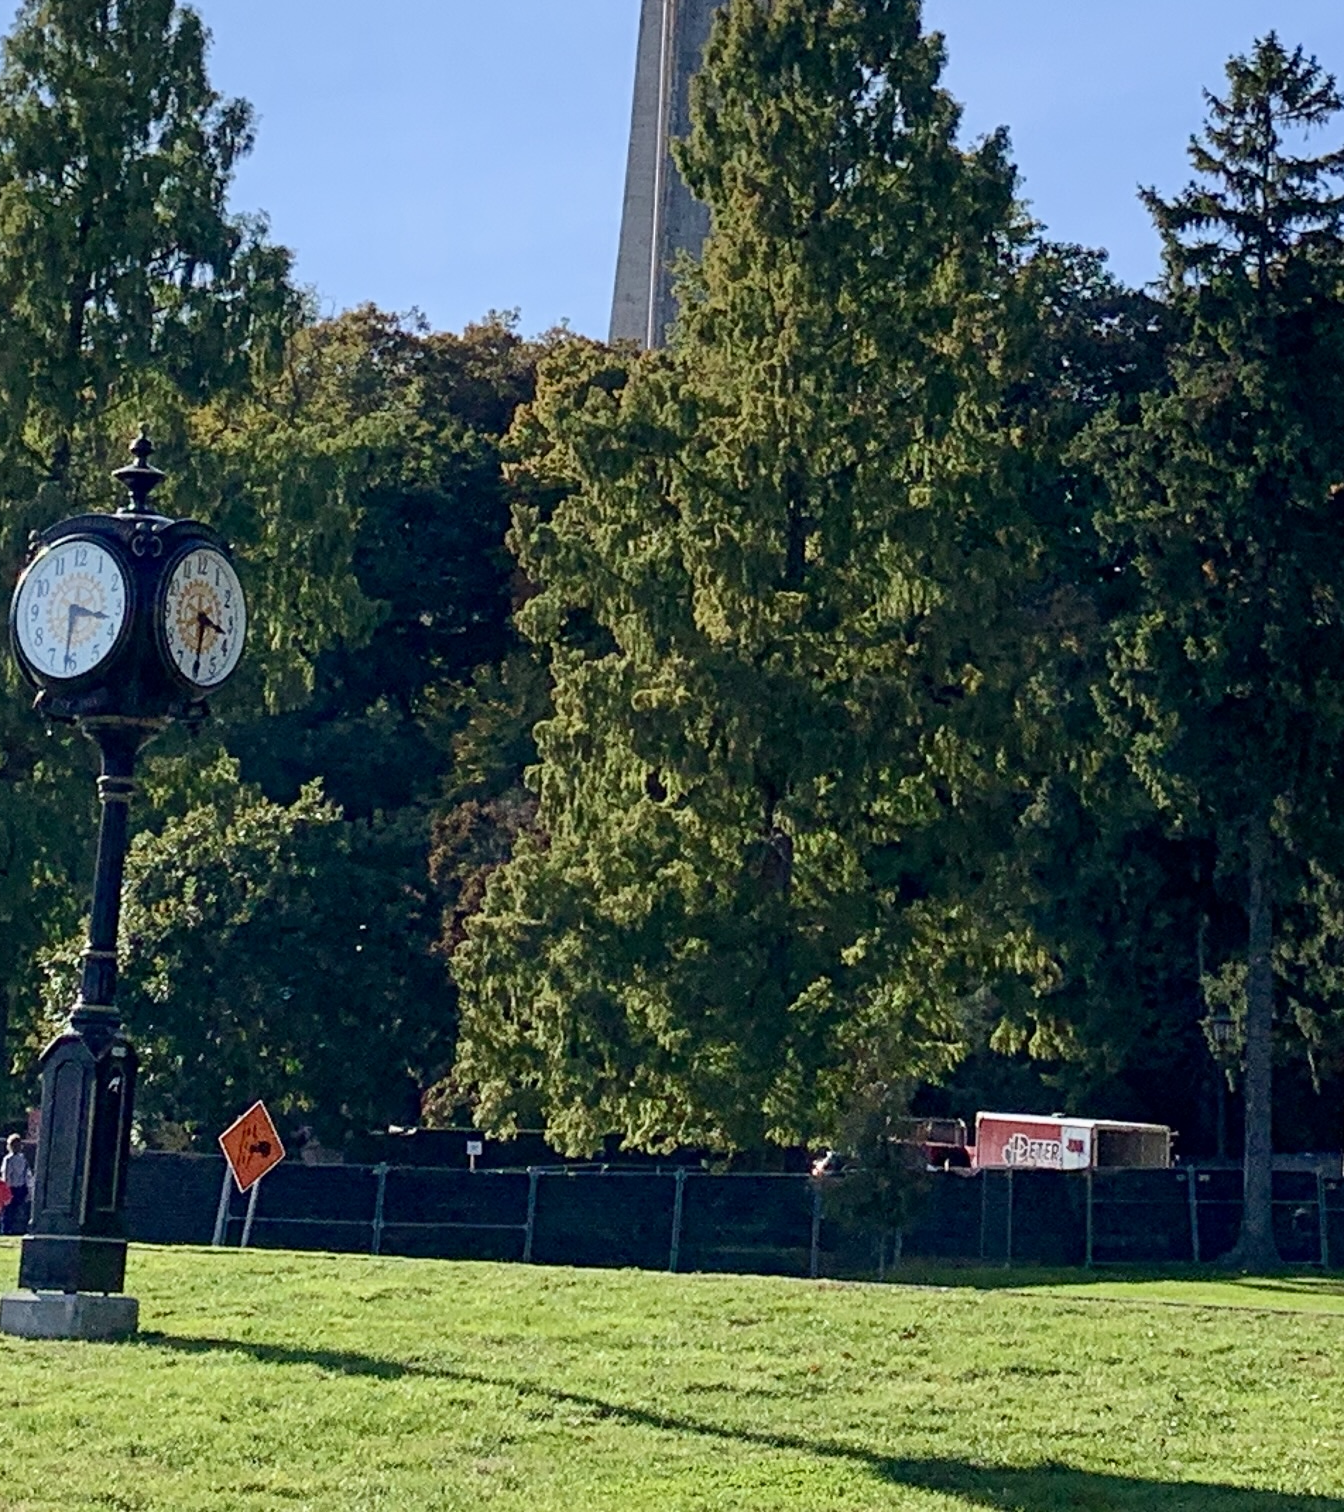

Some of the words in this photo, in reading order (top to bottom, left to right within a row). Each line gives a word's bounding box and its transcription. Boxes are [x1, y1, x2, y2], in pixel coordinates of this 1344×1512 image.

[55, 557, 65, 576] 11
[74, 548, 88, 567] 12
[98, 555, 104, 574] 1
[198, 553, 208, 575] 12
[183, 560, 192, 579] 11
[215, 567, 220, 586] 1
[34, 578, 50, 598] 10
[111, 573, 119, 592] 2
[115, 599, 122, 616] 3
[224, 589, 231, 608] 2
[31, 604, 39, 622] 9
[34, 627, 43, 646] 8
[107, 622, 115, 641] 4
[91, 643, 100, 663] 5
[221, 638, 227, 657] 4
[48, 648, 56, 667] 7
[67, 653, 77, 670] 6
[176, 650, 183, 669] 7
[209, 657, 217, 675] 5
